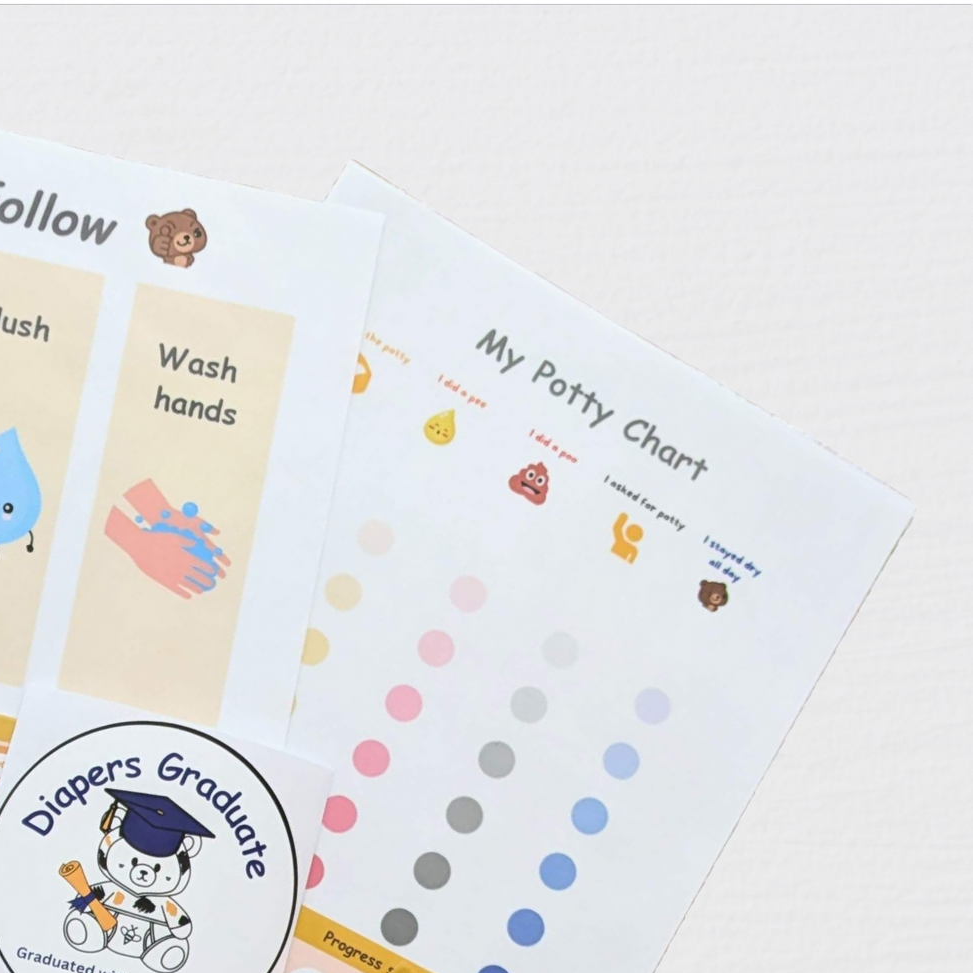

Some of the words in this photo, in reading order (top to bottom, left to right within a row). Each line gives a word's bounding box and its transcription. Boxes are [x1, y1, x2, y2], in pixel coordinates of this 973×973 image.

[159, 343, 237, 383] Wash
[382, 345, 411, 365] potty
[154, 385, 237, 425] hands
[444, 379, 460, 392] did
[467, 395, 487, 408] pee
[476, 329, 525, 374] My
[532, 360, 614, 428] Potty
[622, 419, 708, 482] Chart
[535, 434, 552, 447] did
[558, 450, 578, 464] poo
[610, 480, 640, 501] asked
[640, 498, 656, 512] for
[656, 511, 686, 532] potty
[708, 560, 722, 569] all
[722, 567, 741, 583] day
[709, 541, 745, 564] stayed
[744, 561, 762, 578] dry
[21, 756, 141, 837] Diapers
[157, 752, 267, 880] Graduate
[322, 930, 383, 971] Progress
